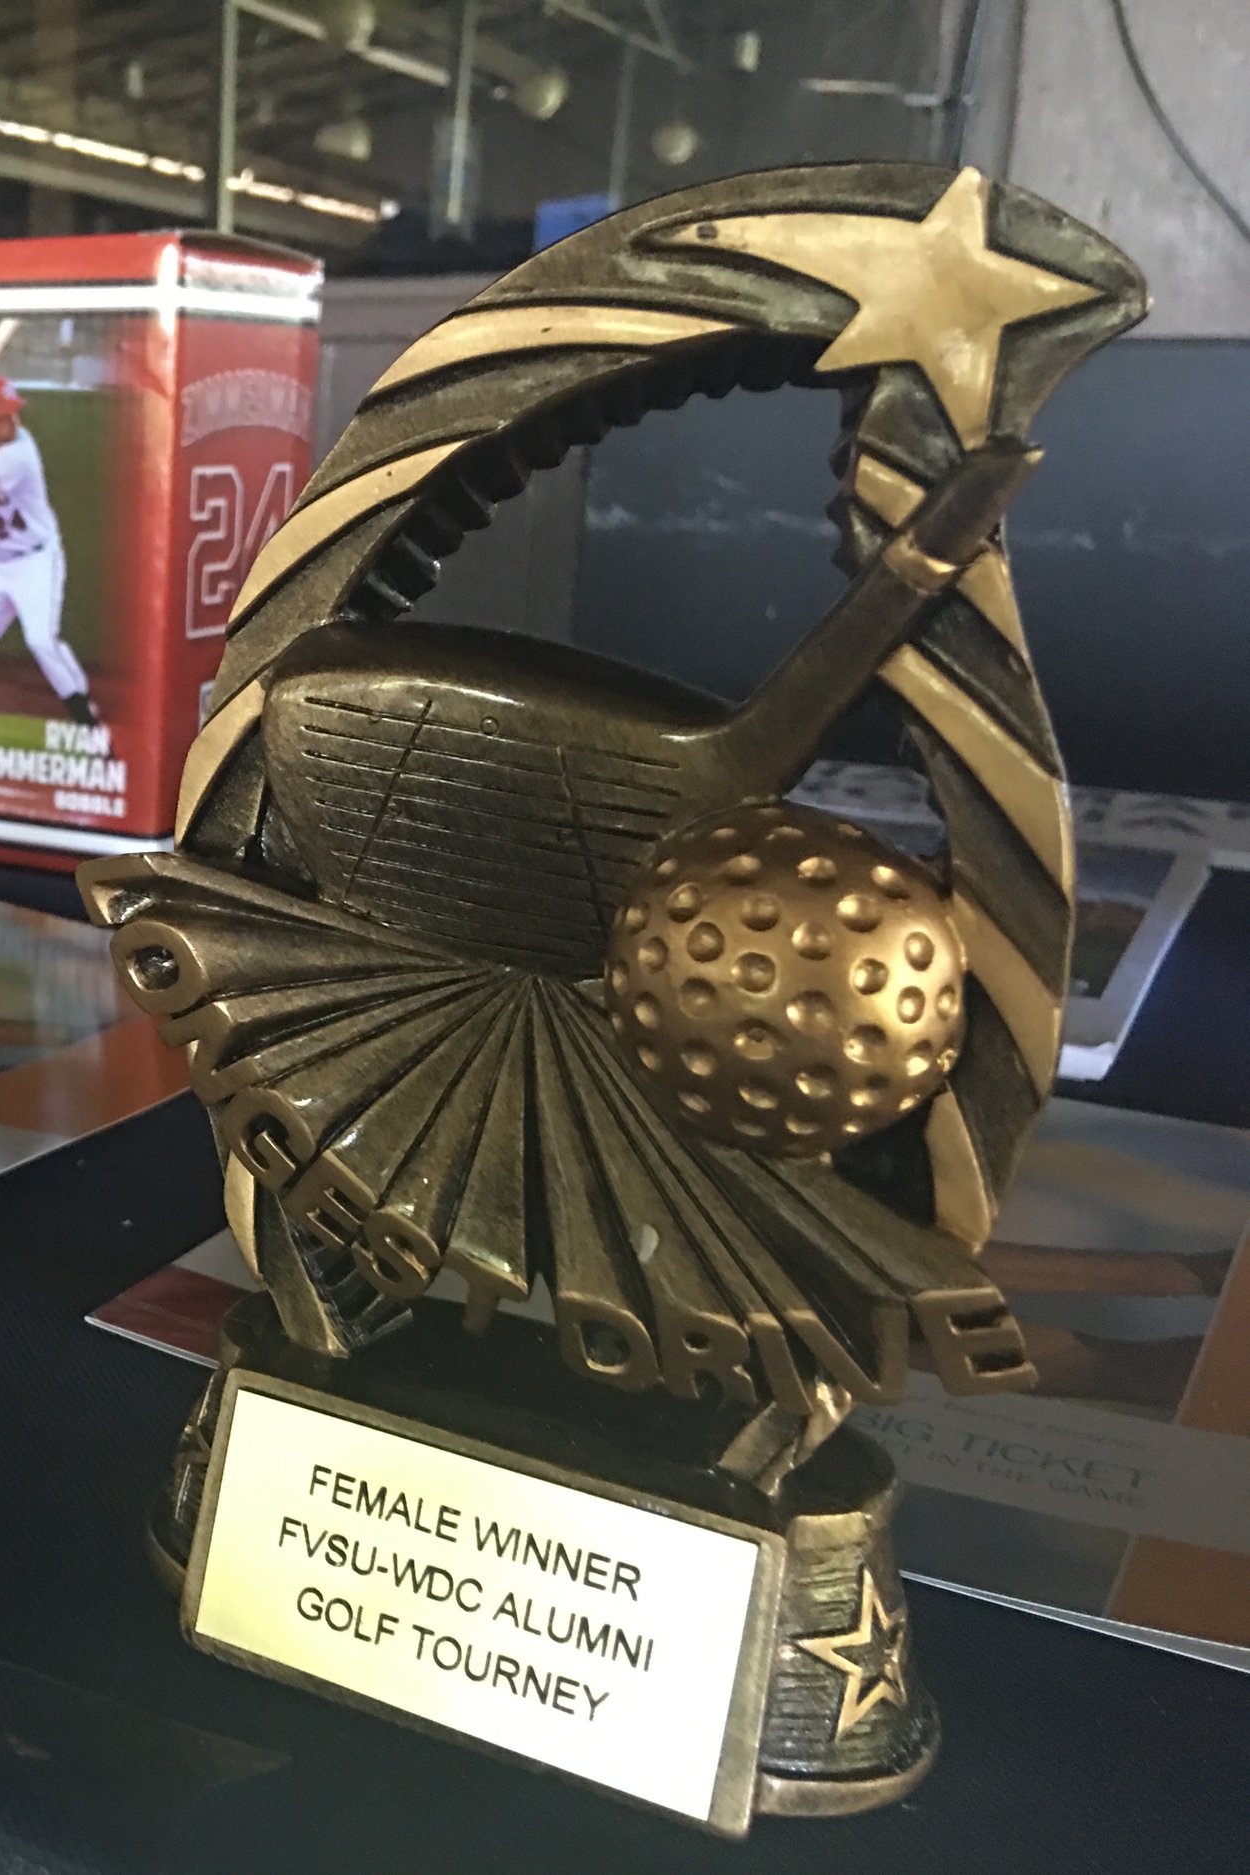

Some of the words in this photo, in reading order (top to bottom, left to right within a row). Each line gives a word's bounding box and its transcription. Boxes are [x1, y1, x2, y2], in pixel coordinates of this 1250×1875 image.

[45, 719, 111, 757] RYAN
[556, 1285, 1039, 1415] DRIVE
[957, 1431, 1156, 1490] TICKET
[277, 1515, 483, 1613] FVSU-WDC
[493, 1591, 655, 1673] ALUMNI
[309, 1464, 462, 1544] FEMALE
[473, 1515, 642, 1602] WINNER
[296, 1586, 400, 1644] GOLF
[412, 1624, 611, 1722] TOURNEY
